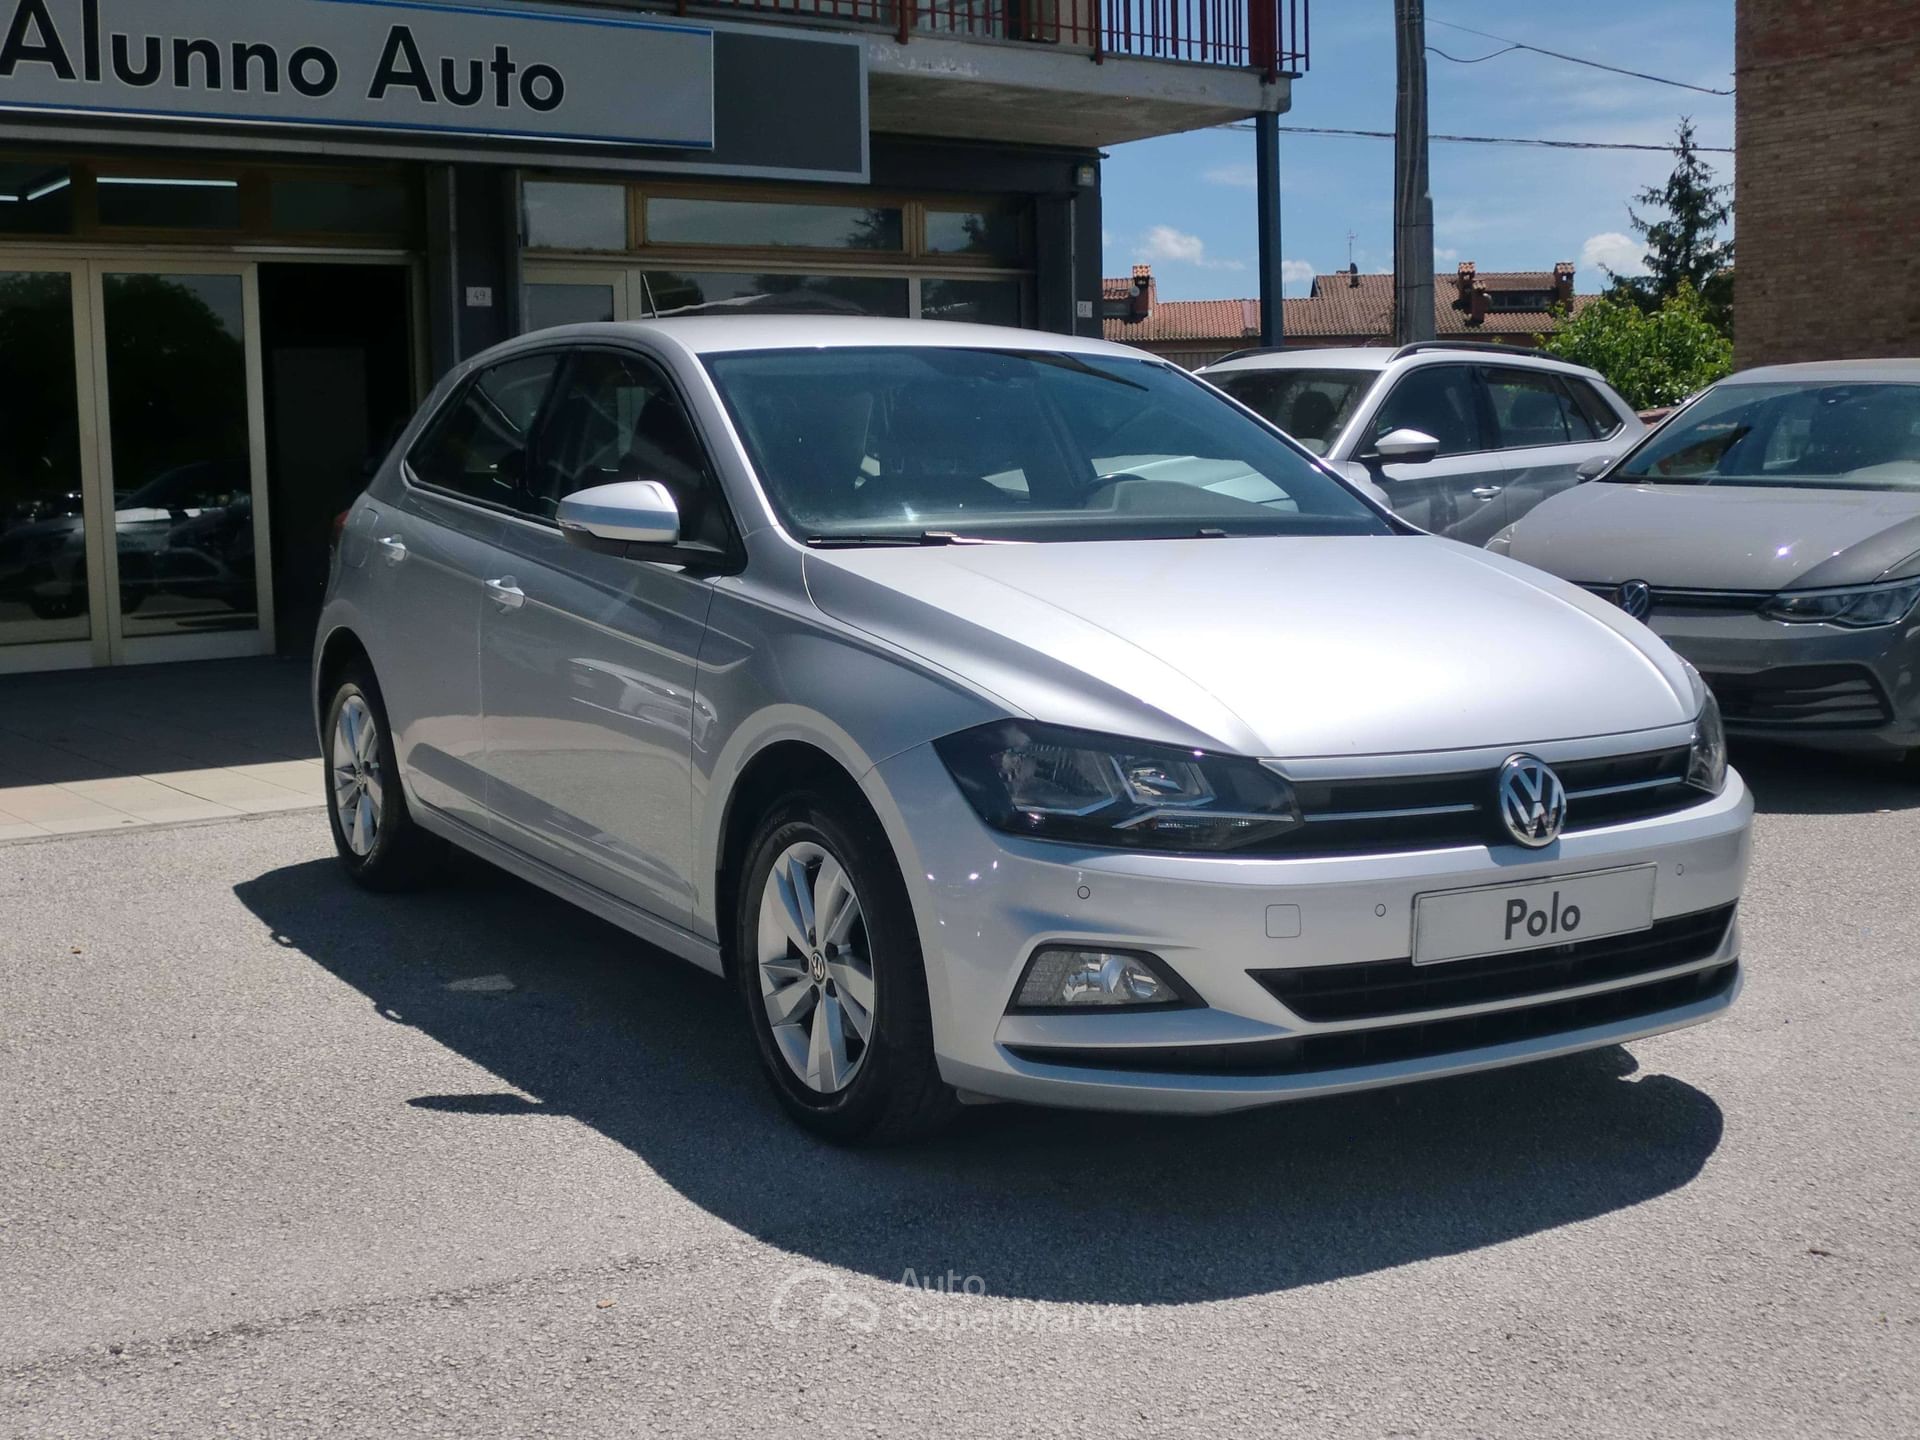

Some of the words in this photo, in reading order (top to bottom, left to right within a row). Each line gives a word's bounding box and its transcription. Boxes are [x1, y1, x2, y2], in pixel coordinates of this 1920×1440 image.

[0, 0, 338, 97] Alunno
[368, 24, 564, 112] Auto
[1504, 891, 1581, 940] Polo
